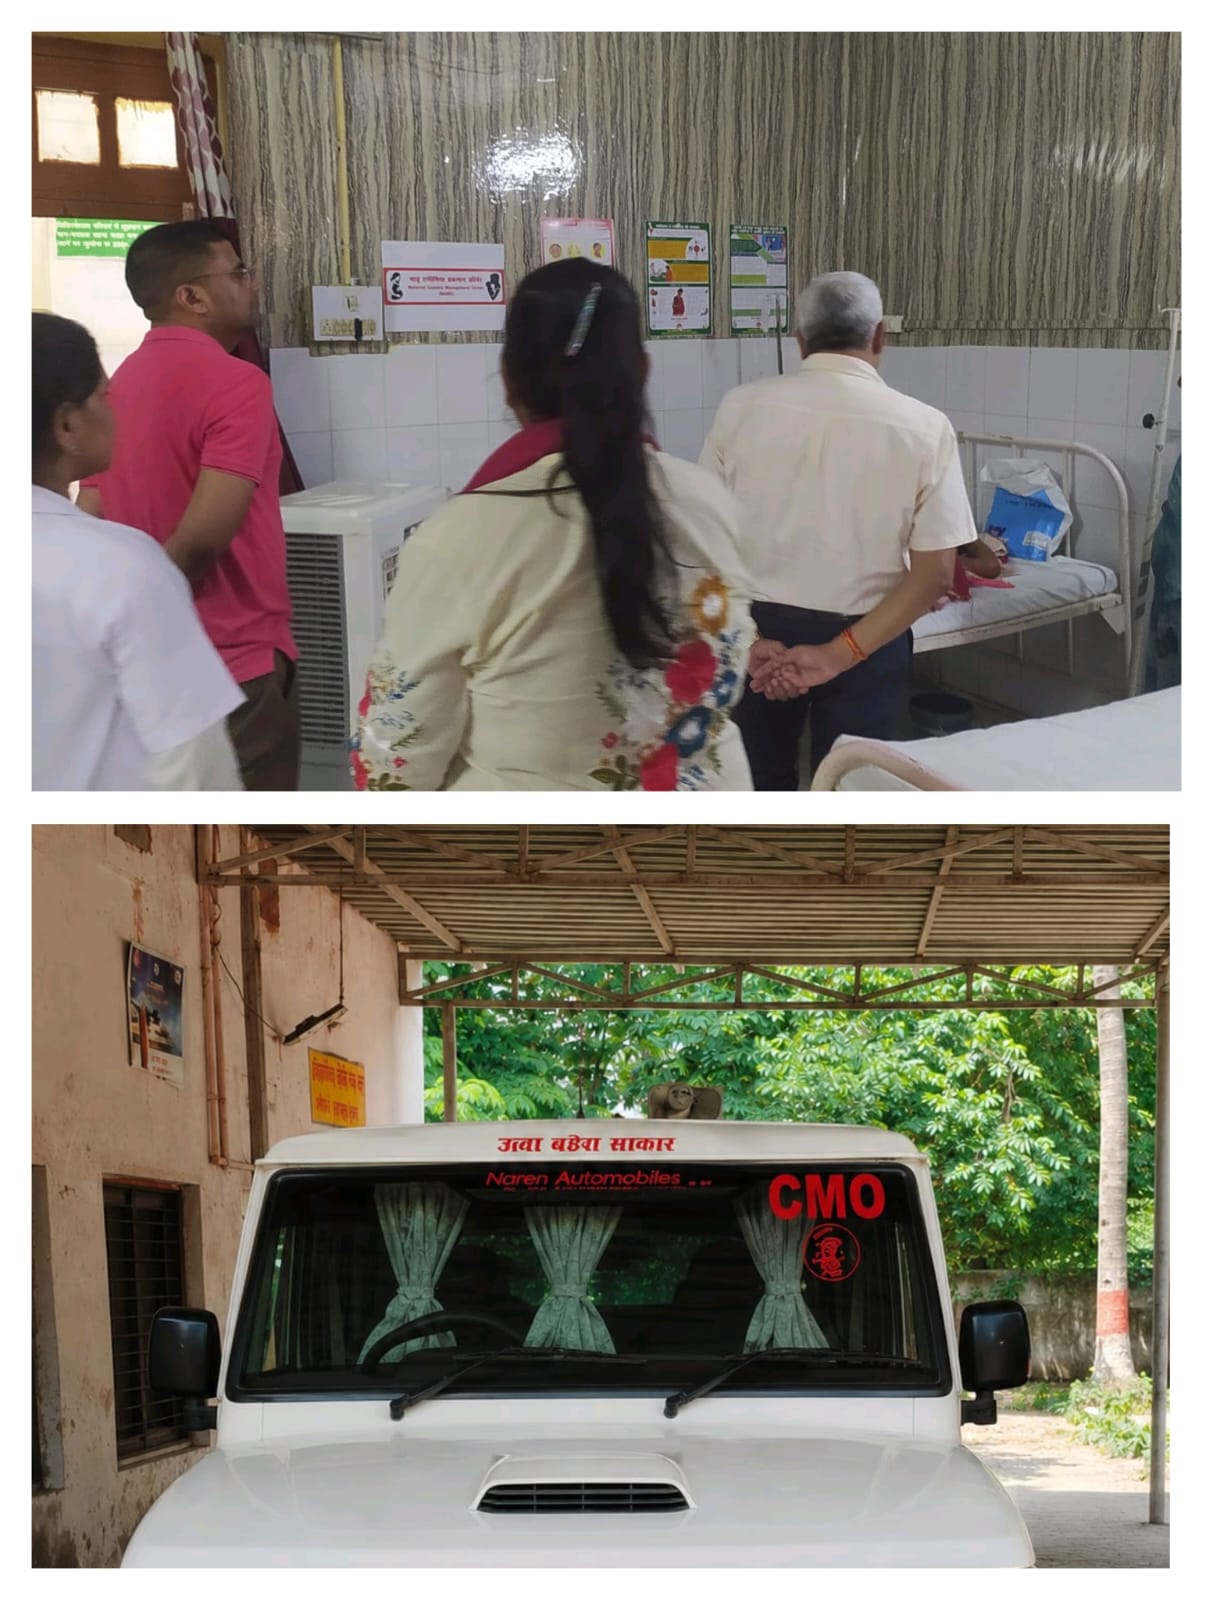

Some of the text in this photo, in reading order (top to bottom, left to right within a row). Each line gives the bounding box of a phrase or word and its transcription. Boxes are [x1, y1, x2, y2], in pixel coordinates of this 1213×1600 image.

[485, 1171, 549, 1187] Naren
[554, 1170, 681, 1187] Automobiles
[768, 1173, 886, 1220] CMO
